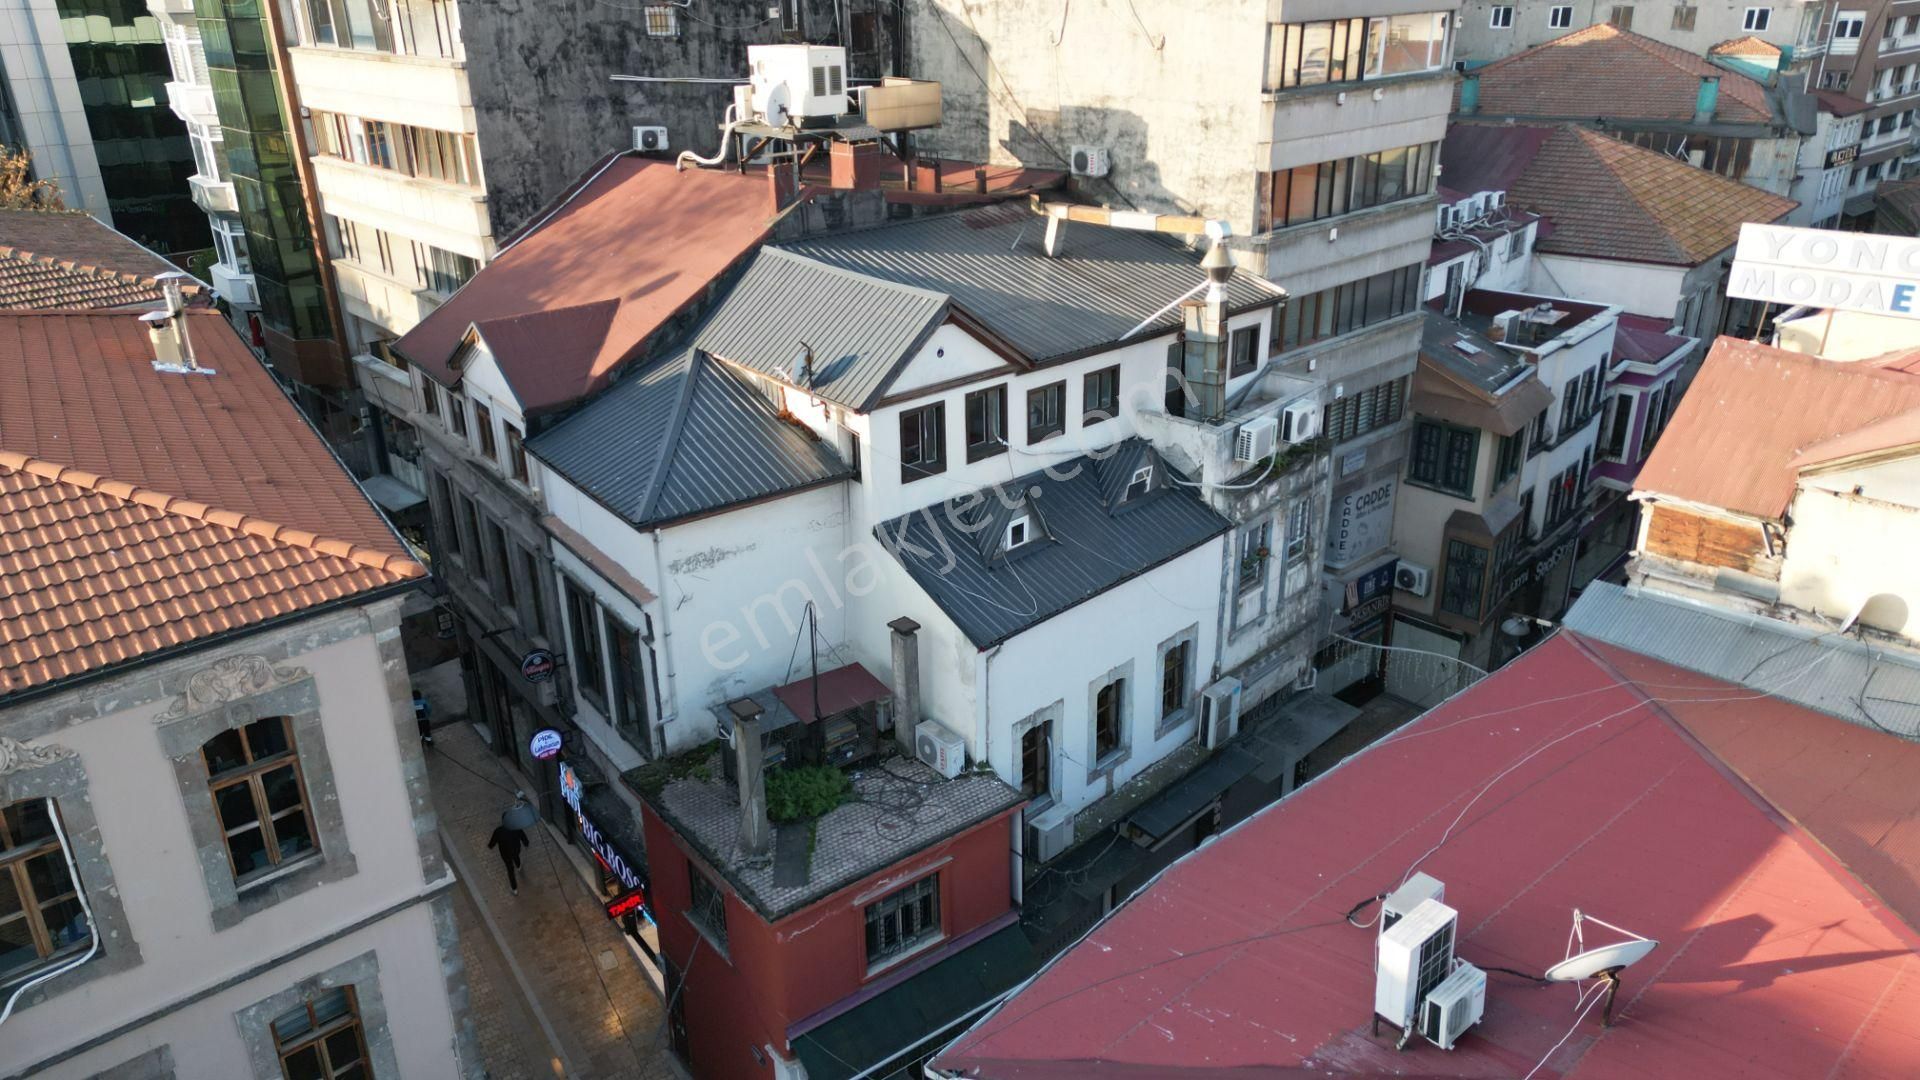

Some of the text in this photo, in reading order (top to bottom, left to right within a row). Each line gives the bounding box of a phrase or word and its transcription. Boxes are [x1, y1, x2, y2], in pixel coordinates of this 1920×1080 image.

[1356, 483, 1392, 511] CADDE
[1339, 495, 1353, 551] CADDE
[581, 814, 605, 857] BIG
